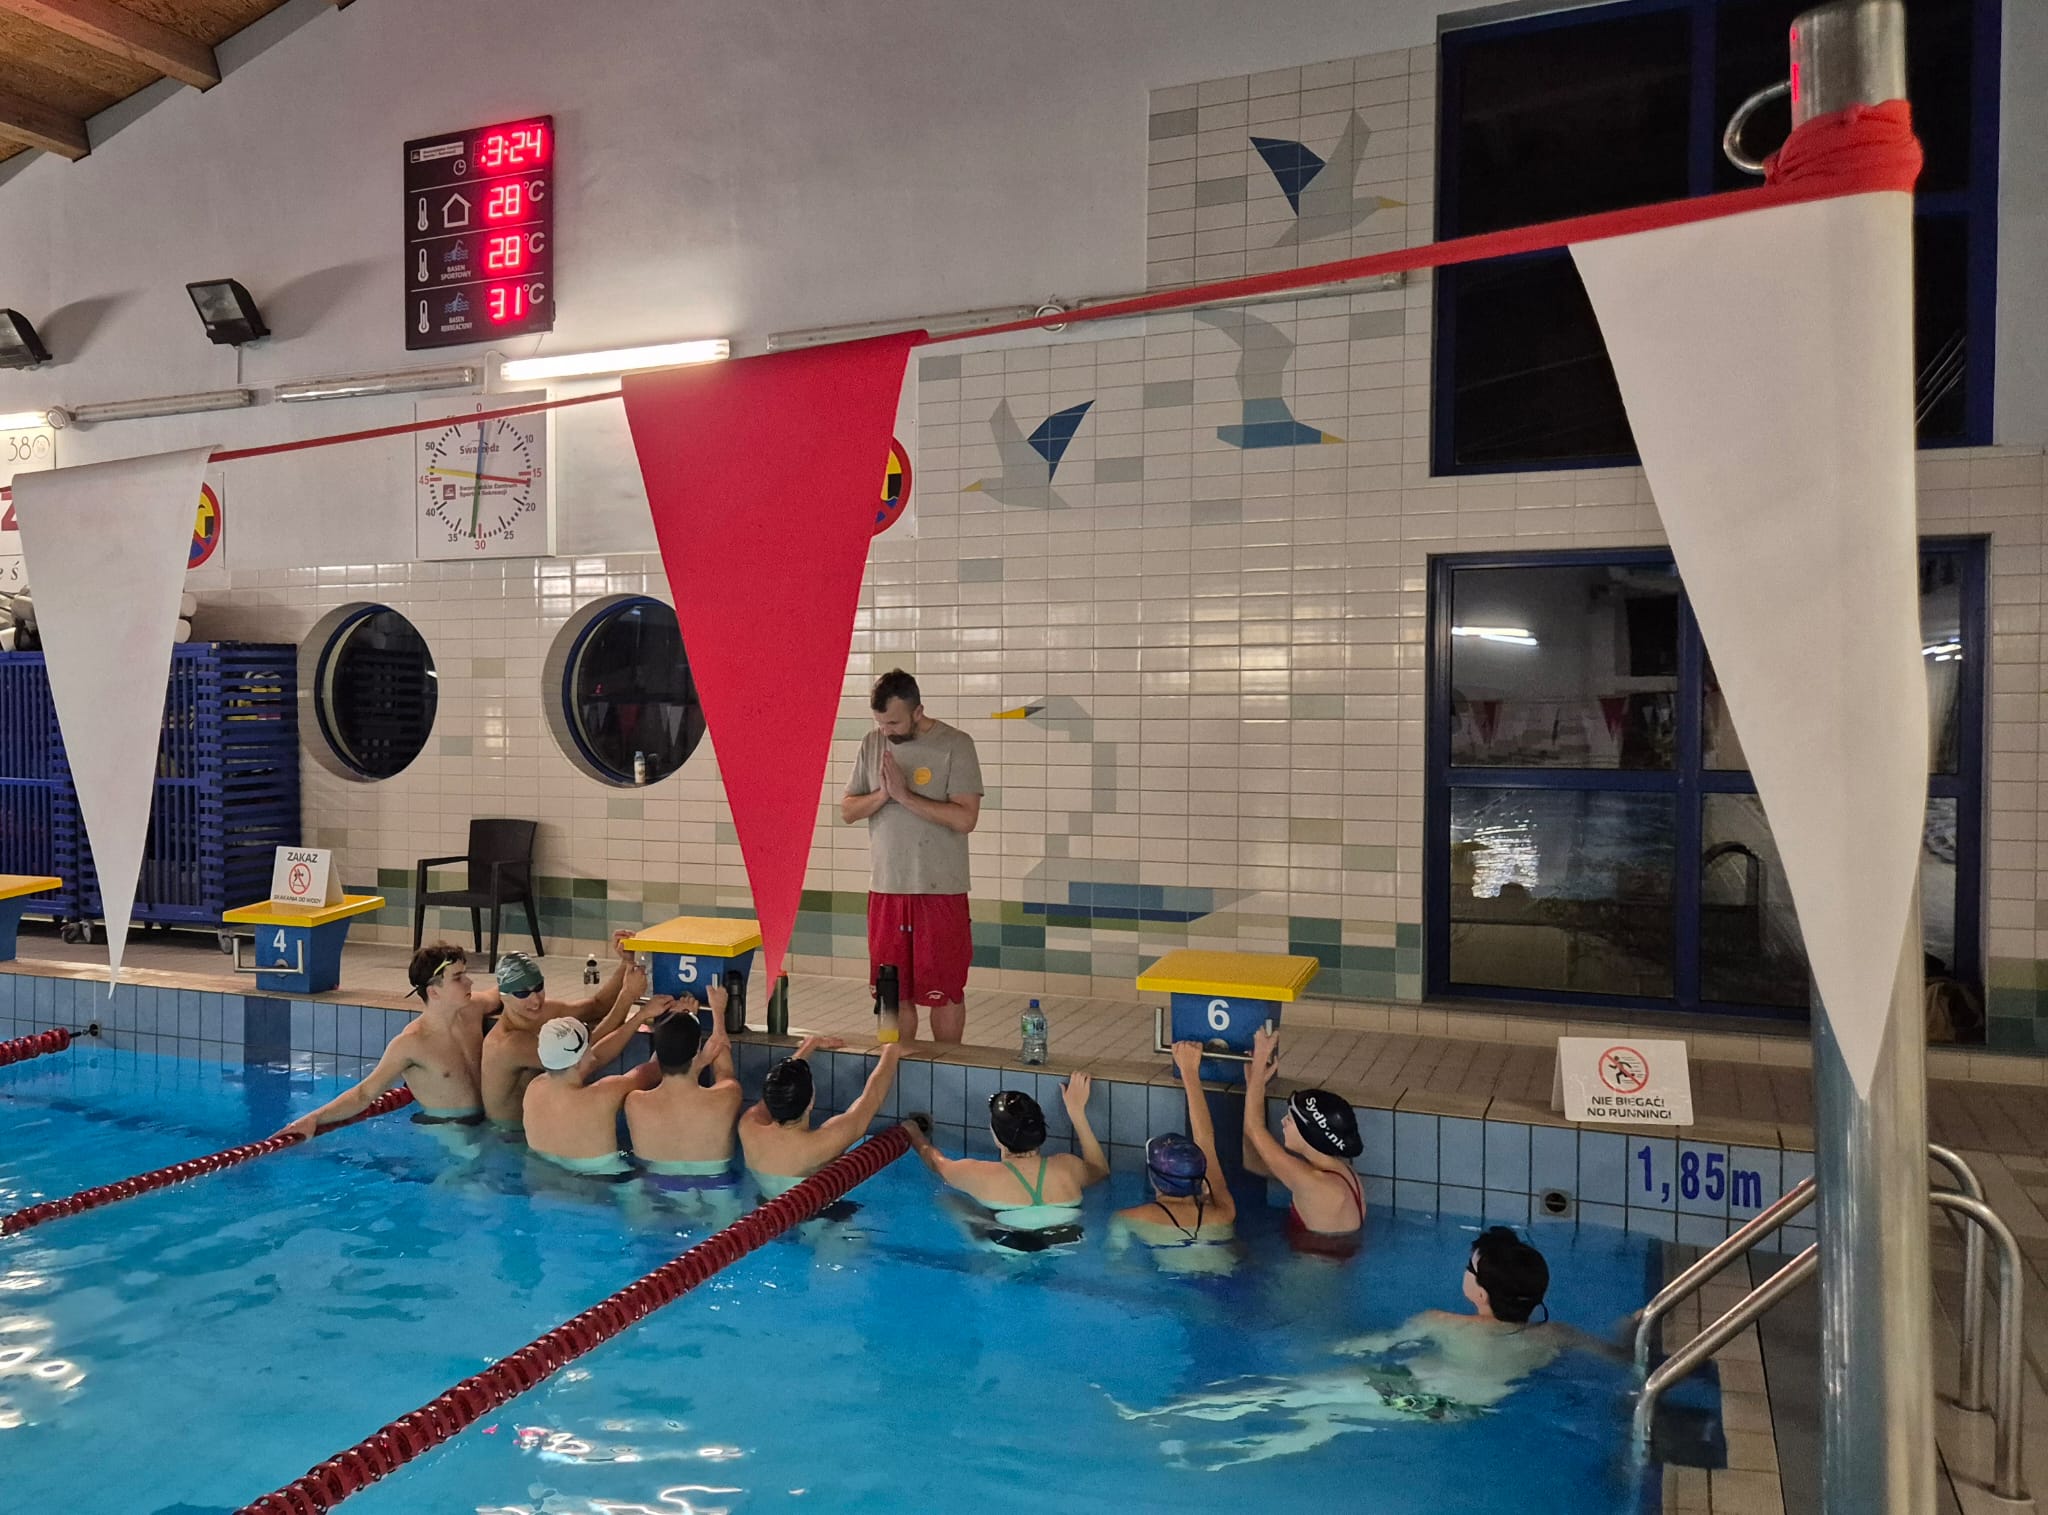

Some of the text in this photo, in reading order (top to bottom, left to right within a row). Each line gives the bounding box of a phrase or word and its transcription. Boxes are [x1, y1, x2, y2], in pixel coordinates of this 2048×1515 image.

[476, 403, 482, 412] 0
[525, 434, 534, 443] 10
[425, 441, 435, 451] 50
[533, 468, 542, 477] 15
[419, 476, 430, 485] 45
[425, 508, 436, 517] 40
[525, 503, 536, 512] 20
[447, 533, 458, 542] 35
[503, 531, 514, 540] 25
[474, 540, 486, 550] 30
[287, 852, 318, 863] ZAKAZ
[273, 929, 287, 953] 4
[678, 956, 698, 983] 5
[1207, 999, 1231, 1031] 6
[1591, 1096, 1665, 1107] NIE BIEGAĆ!
[1587, 1107, 1672, 1119] NO RUNNING!
[1637, 1145, 1762, 1209] 1,85m
